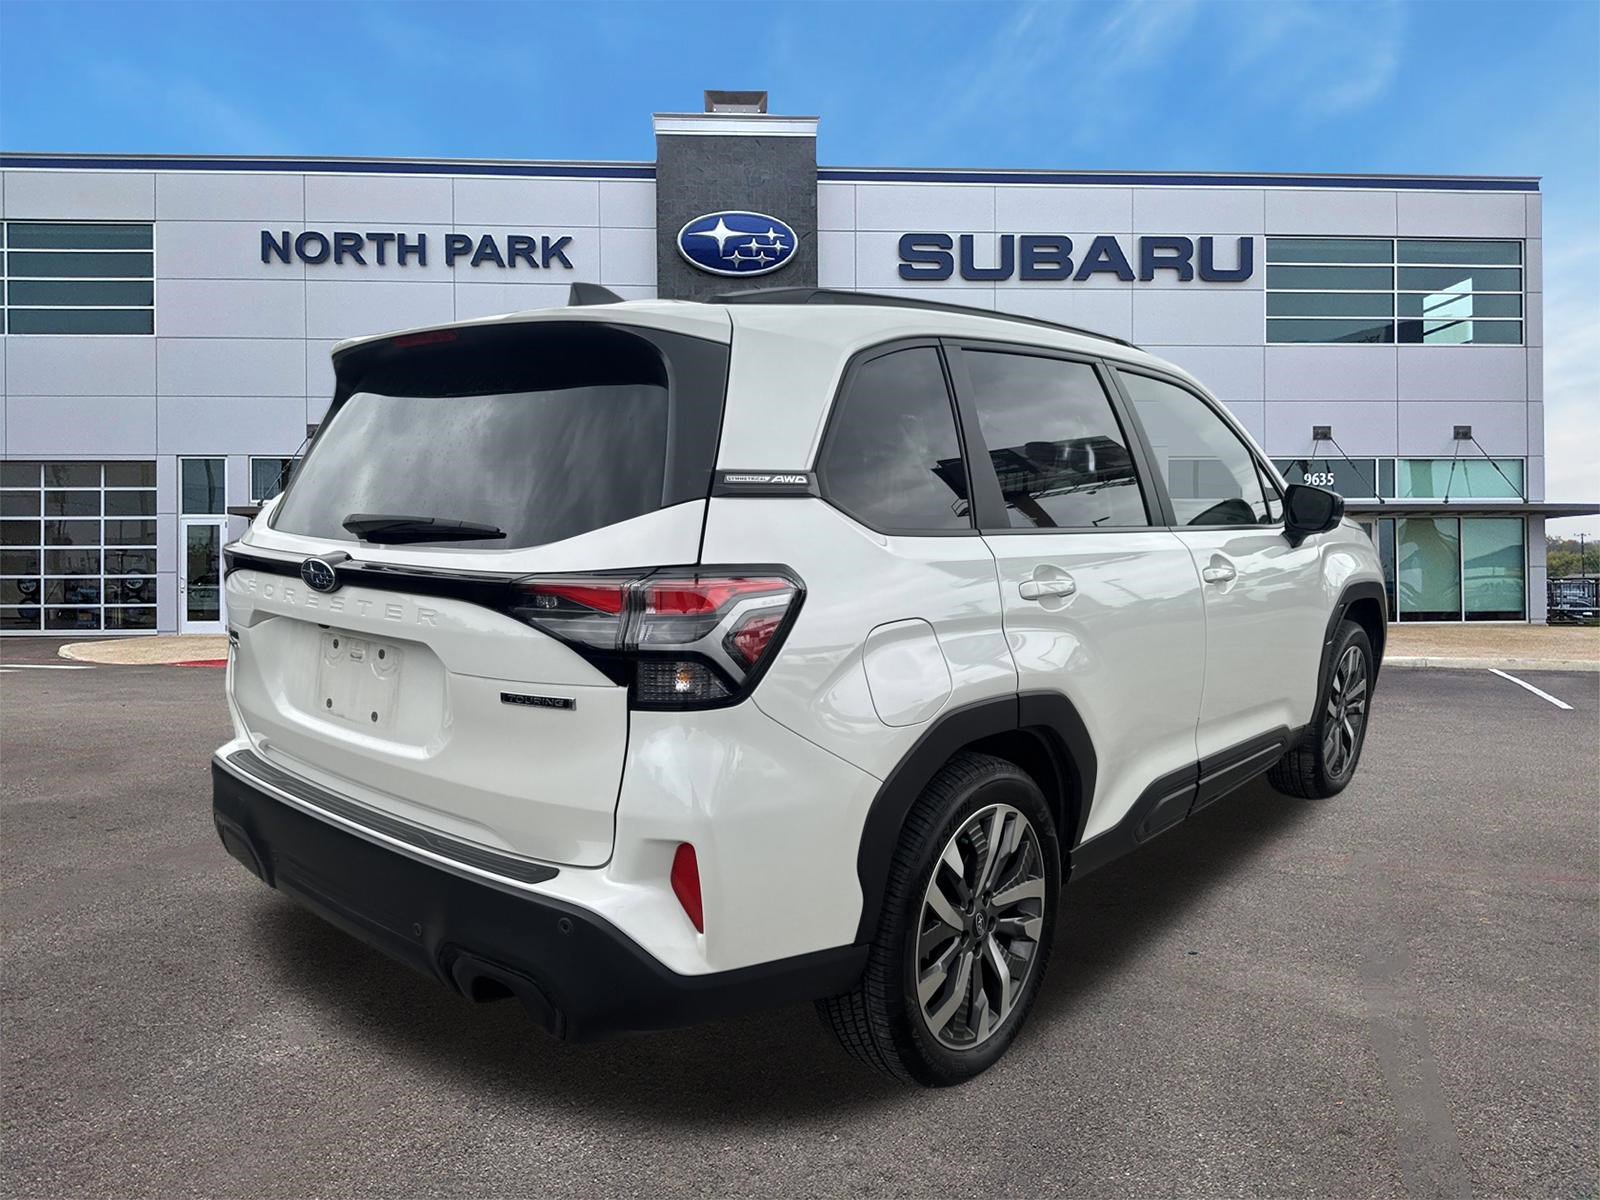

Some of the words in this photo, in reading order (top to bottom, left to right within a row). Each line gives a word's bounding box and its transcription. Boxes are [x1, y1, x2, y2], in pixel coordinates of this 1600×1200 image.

[260, 230, 427, 267] NORTH
[444, 233, 574, 269] PARK
[897, 232, 1255, 283] SUBARU
[770, 475, 808, 484] AWD
[1303, 472, 1335, 486] 9635
[247, 579, 441, 627] FORESTER
[507, 694, 565, 708] TOURING
